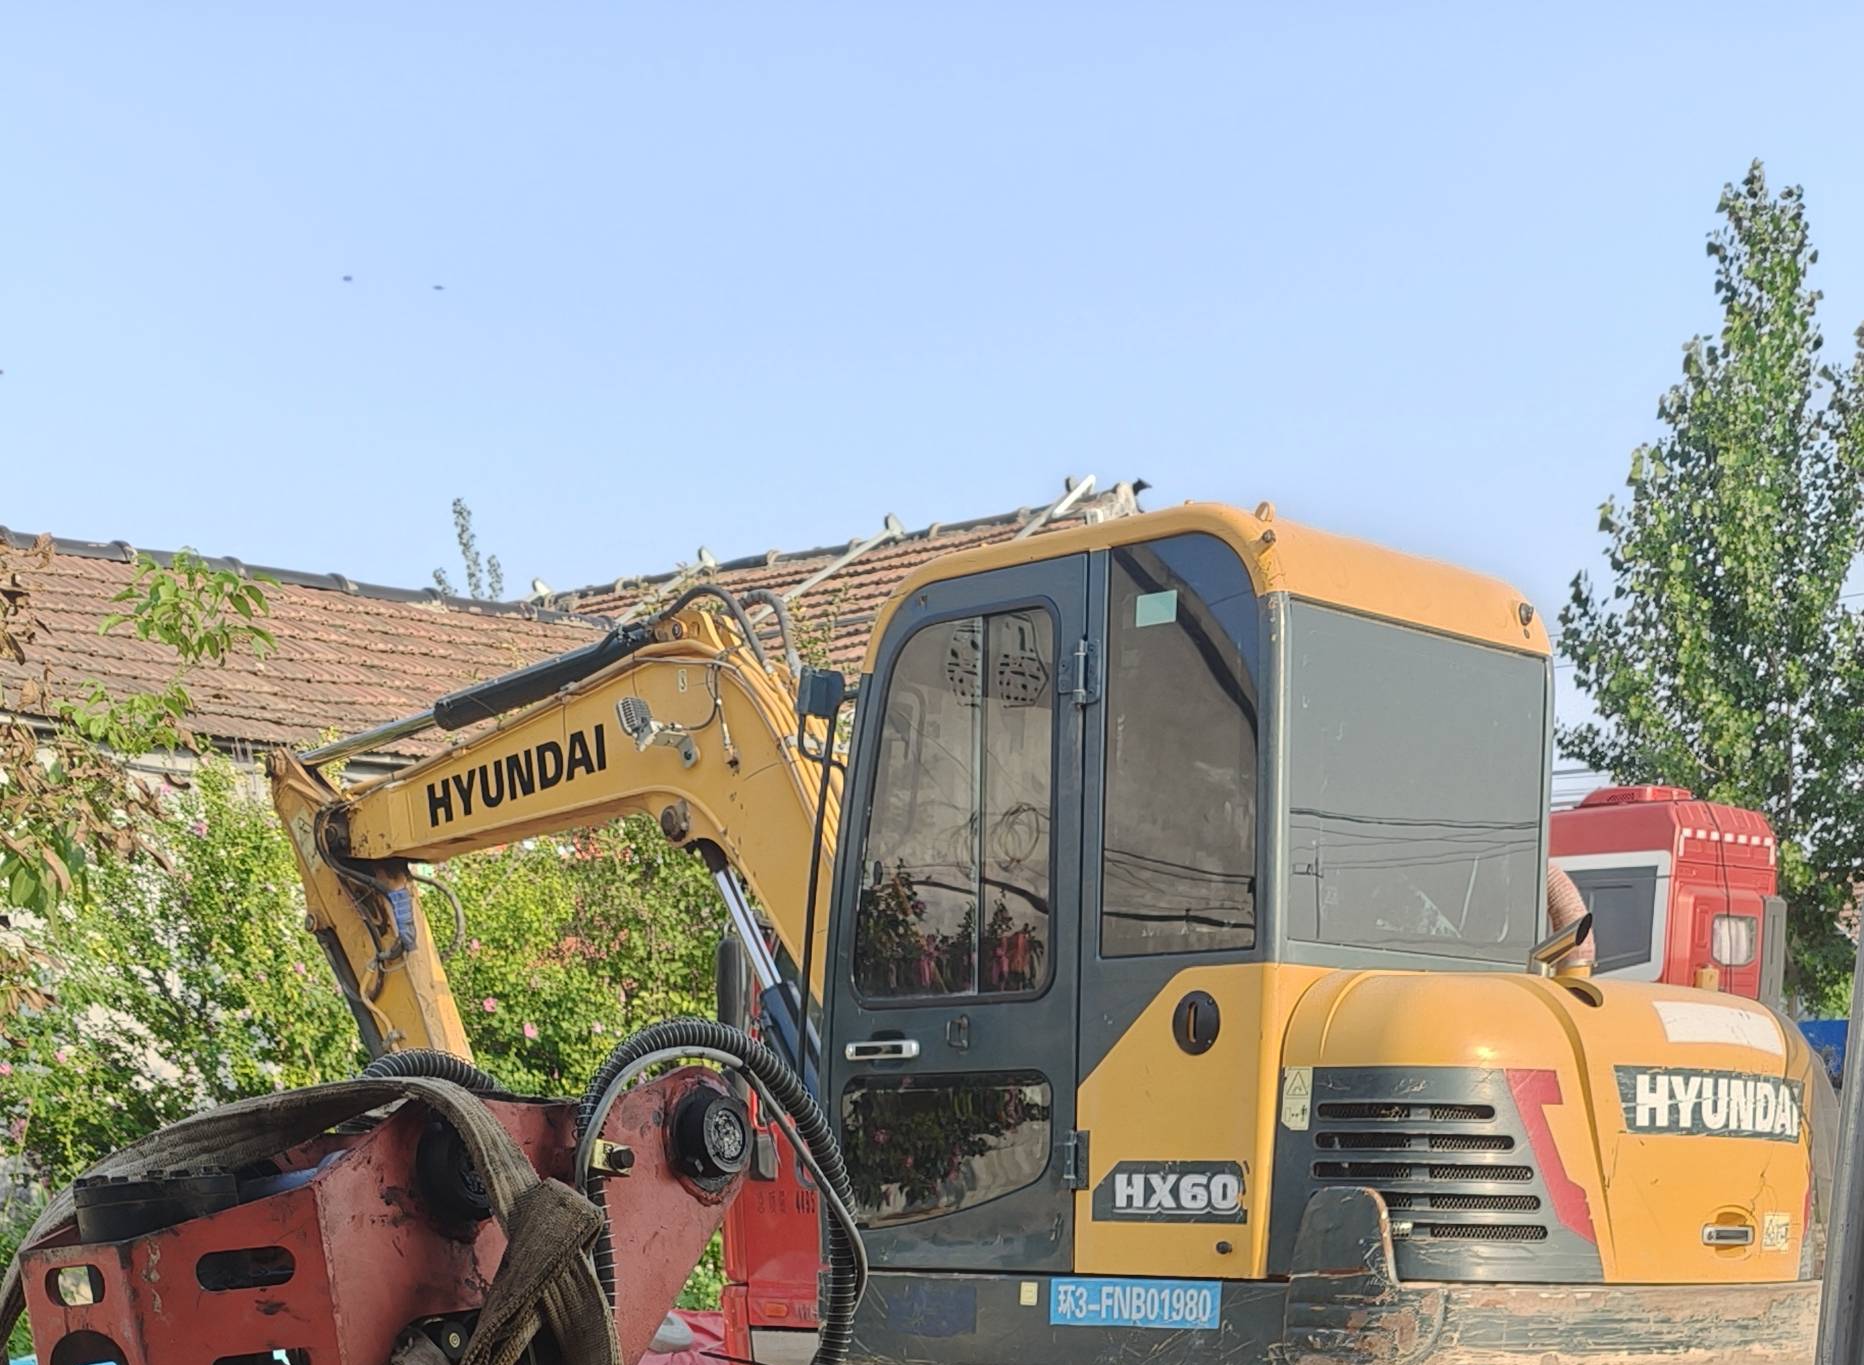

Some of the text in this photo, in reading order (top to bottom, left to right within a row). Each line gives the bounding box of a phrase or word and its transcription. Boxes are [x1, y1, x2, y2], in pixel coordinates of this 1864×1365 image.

[427, 724, 607, 828] HYUNDAI
[1114, 1173, 1240, 1212] HX60
[1057, 1284, 1212, 1322] 环3-FNB01980
